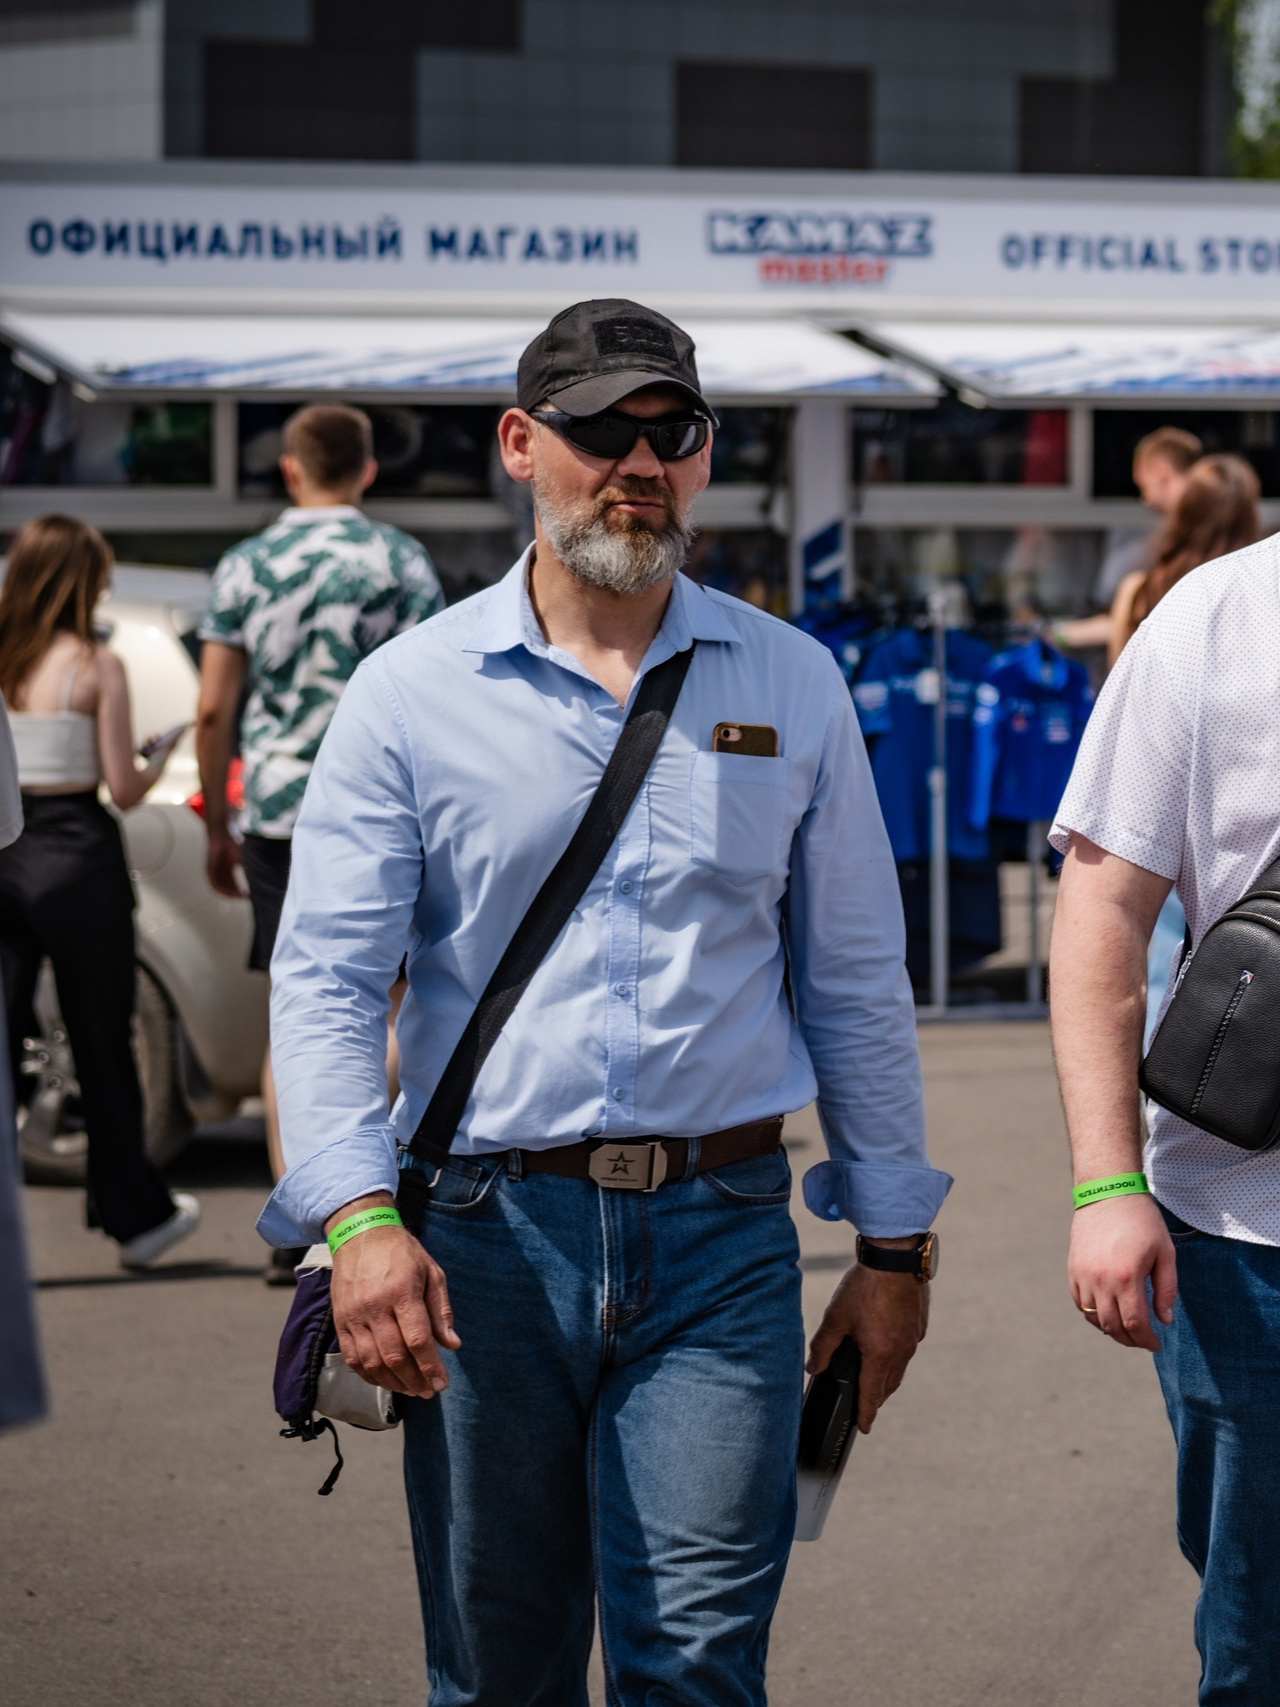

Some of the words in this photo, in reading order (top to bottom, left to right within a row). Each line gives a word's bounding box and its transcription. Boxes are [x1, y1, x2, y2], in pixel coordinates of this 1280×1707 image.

[27, 215, 404, 264] ОФИЦИАЛЬНЫЙ
[427, 224, 639, 264] МАГАЗИН
[707, 211, 935, 256] KAMAZ
[759, 254, 890, 285] master
[1000, 233, 1187, 272] OFFICIAL
[1078, 1180, 1136, 1198] ПОСЕТИТЕЛЬ
[336, 1213, 395, 1238] ПОСЕТИТЕЛЬ
